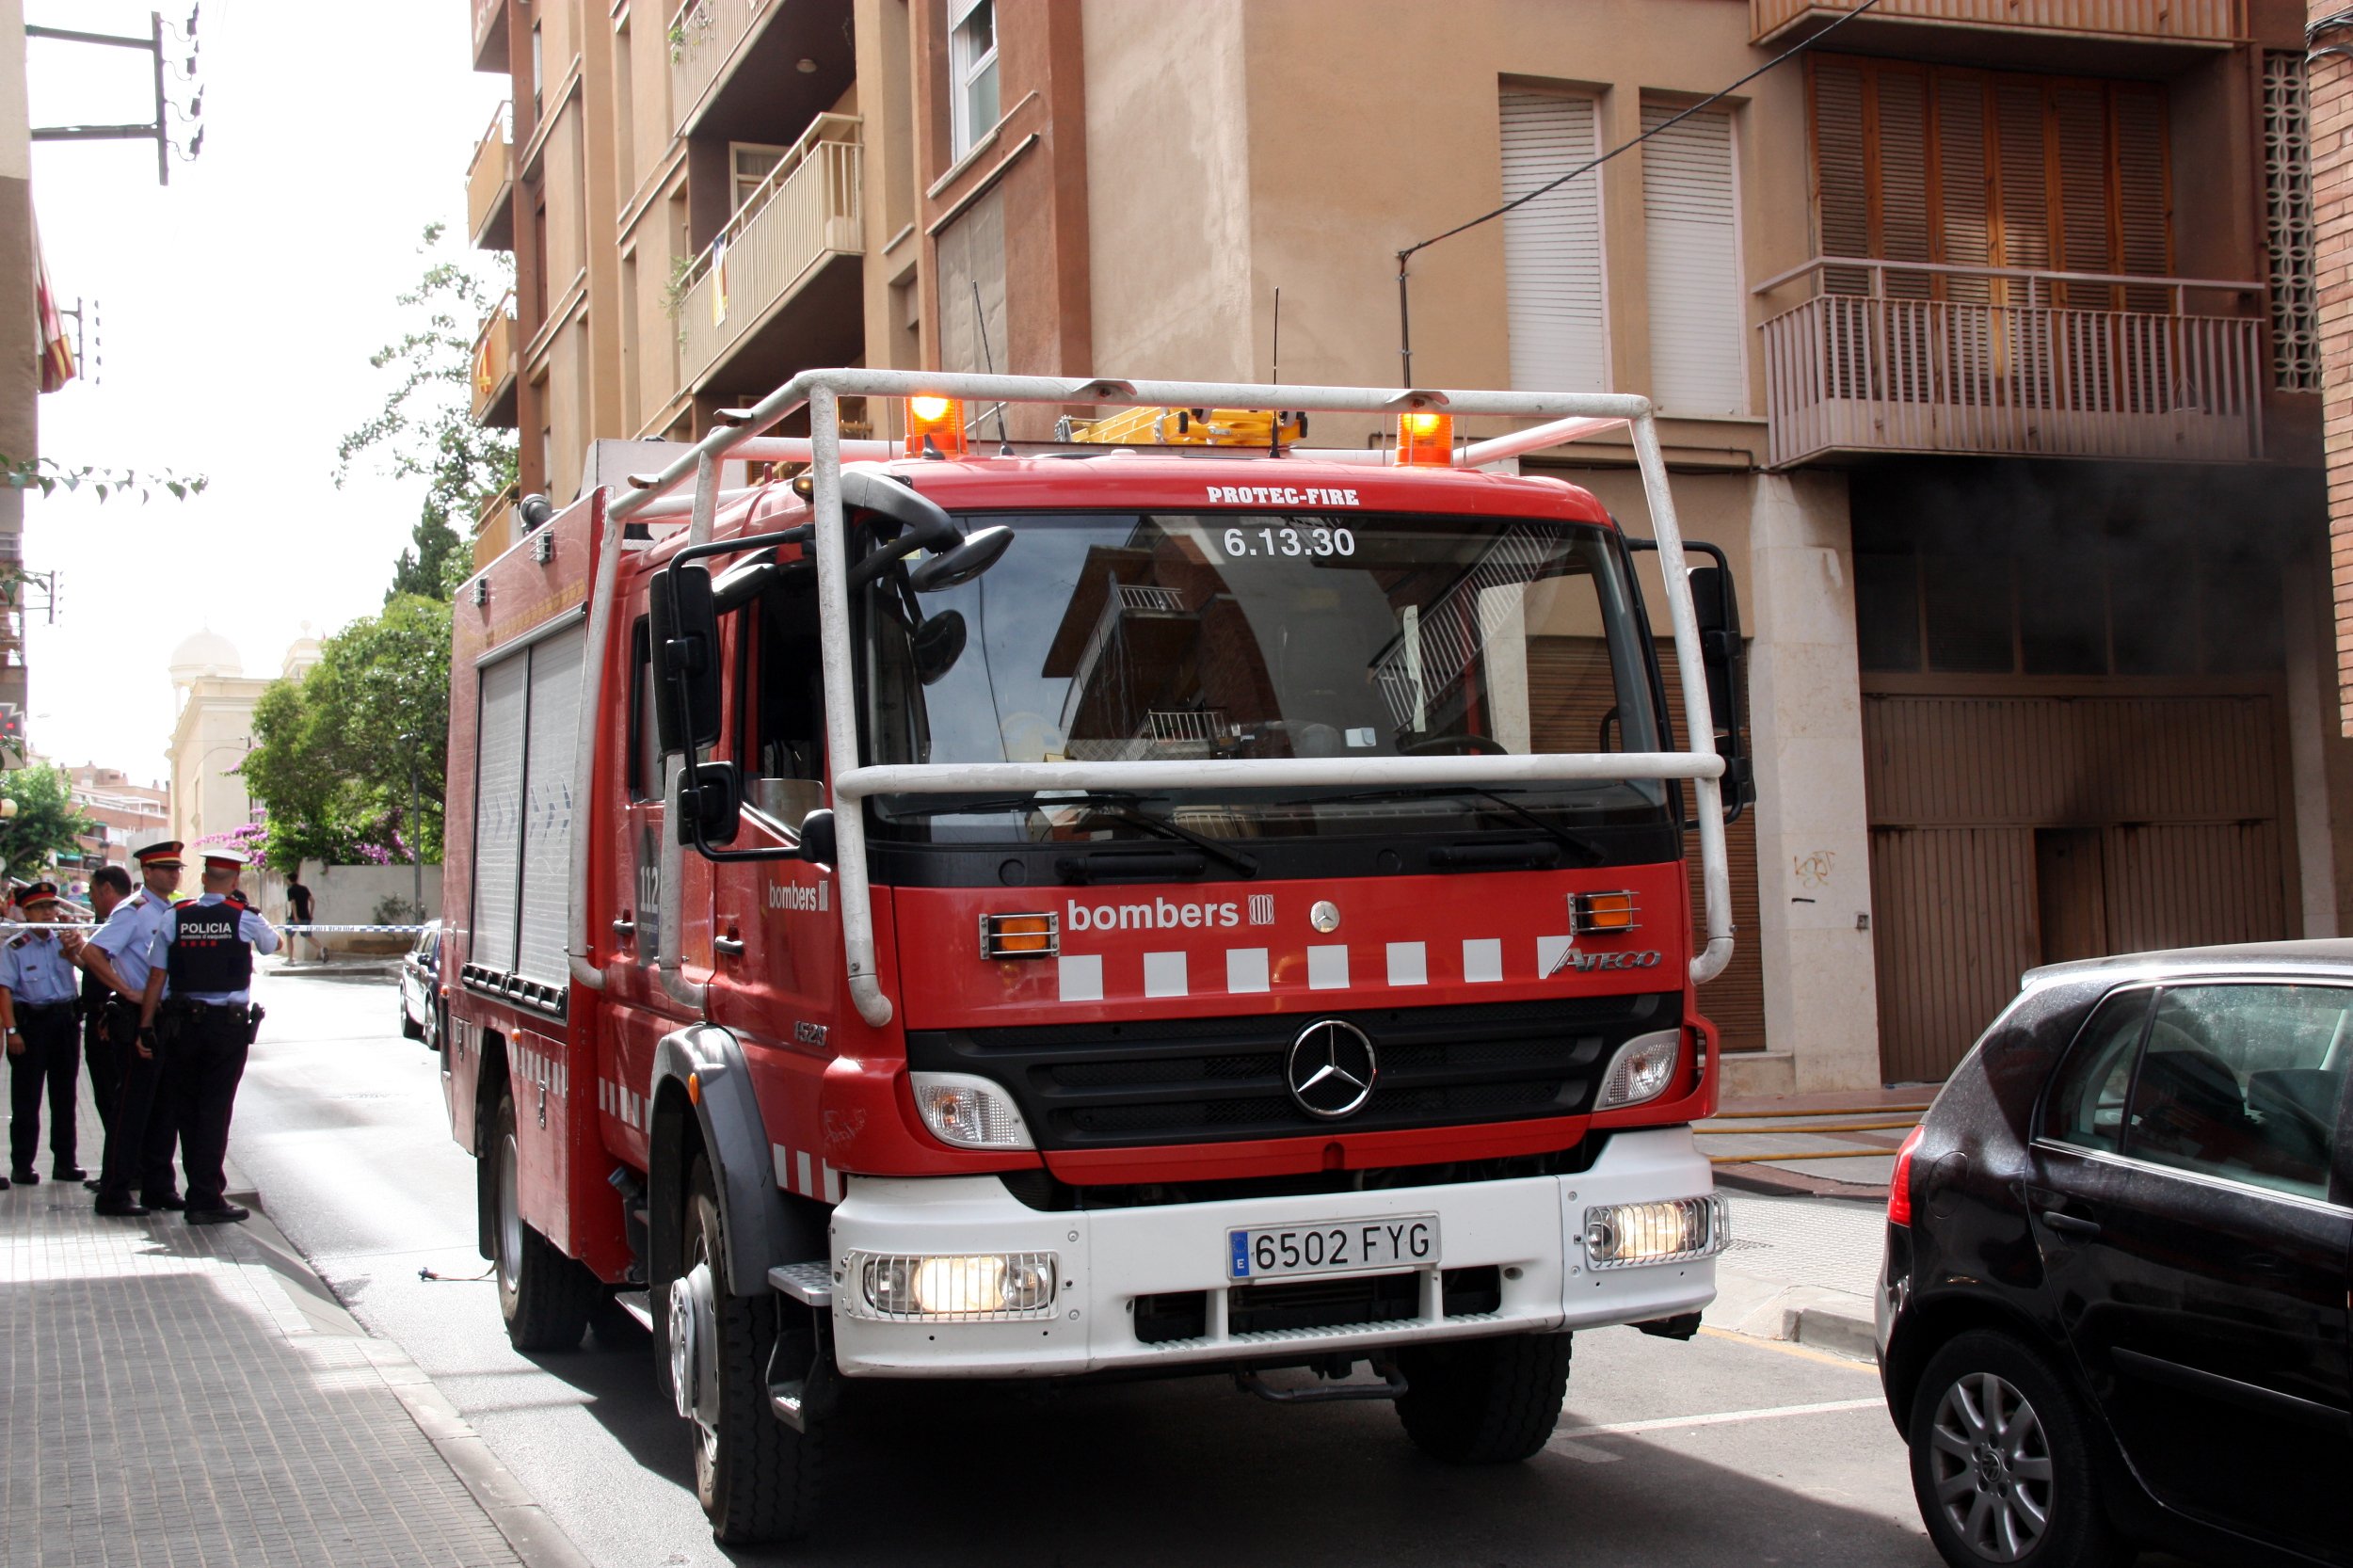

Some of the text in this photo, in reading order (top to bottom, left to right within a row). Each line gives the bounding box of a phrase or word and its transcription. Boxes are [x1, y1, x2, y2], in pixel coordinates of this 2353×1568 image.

[1207, 487, 1360, 505] PROTEC-FIRE
[1225, 528, 1355, 556] 6.13.30
[640, 866, 659, 914] 112
[769, 878, 817, 912] bombers
[181, 923, 232, 934] POLICIA
[1067, 897, 1240, 931] bombers
[1256, 1224, 1429, 1270] 6502 FYG
[1237, 1258, 1244, 1269] E
